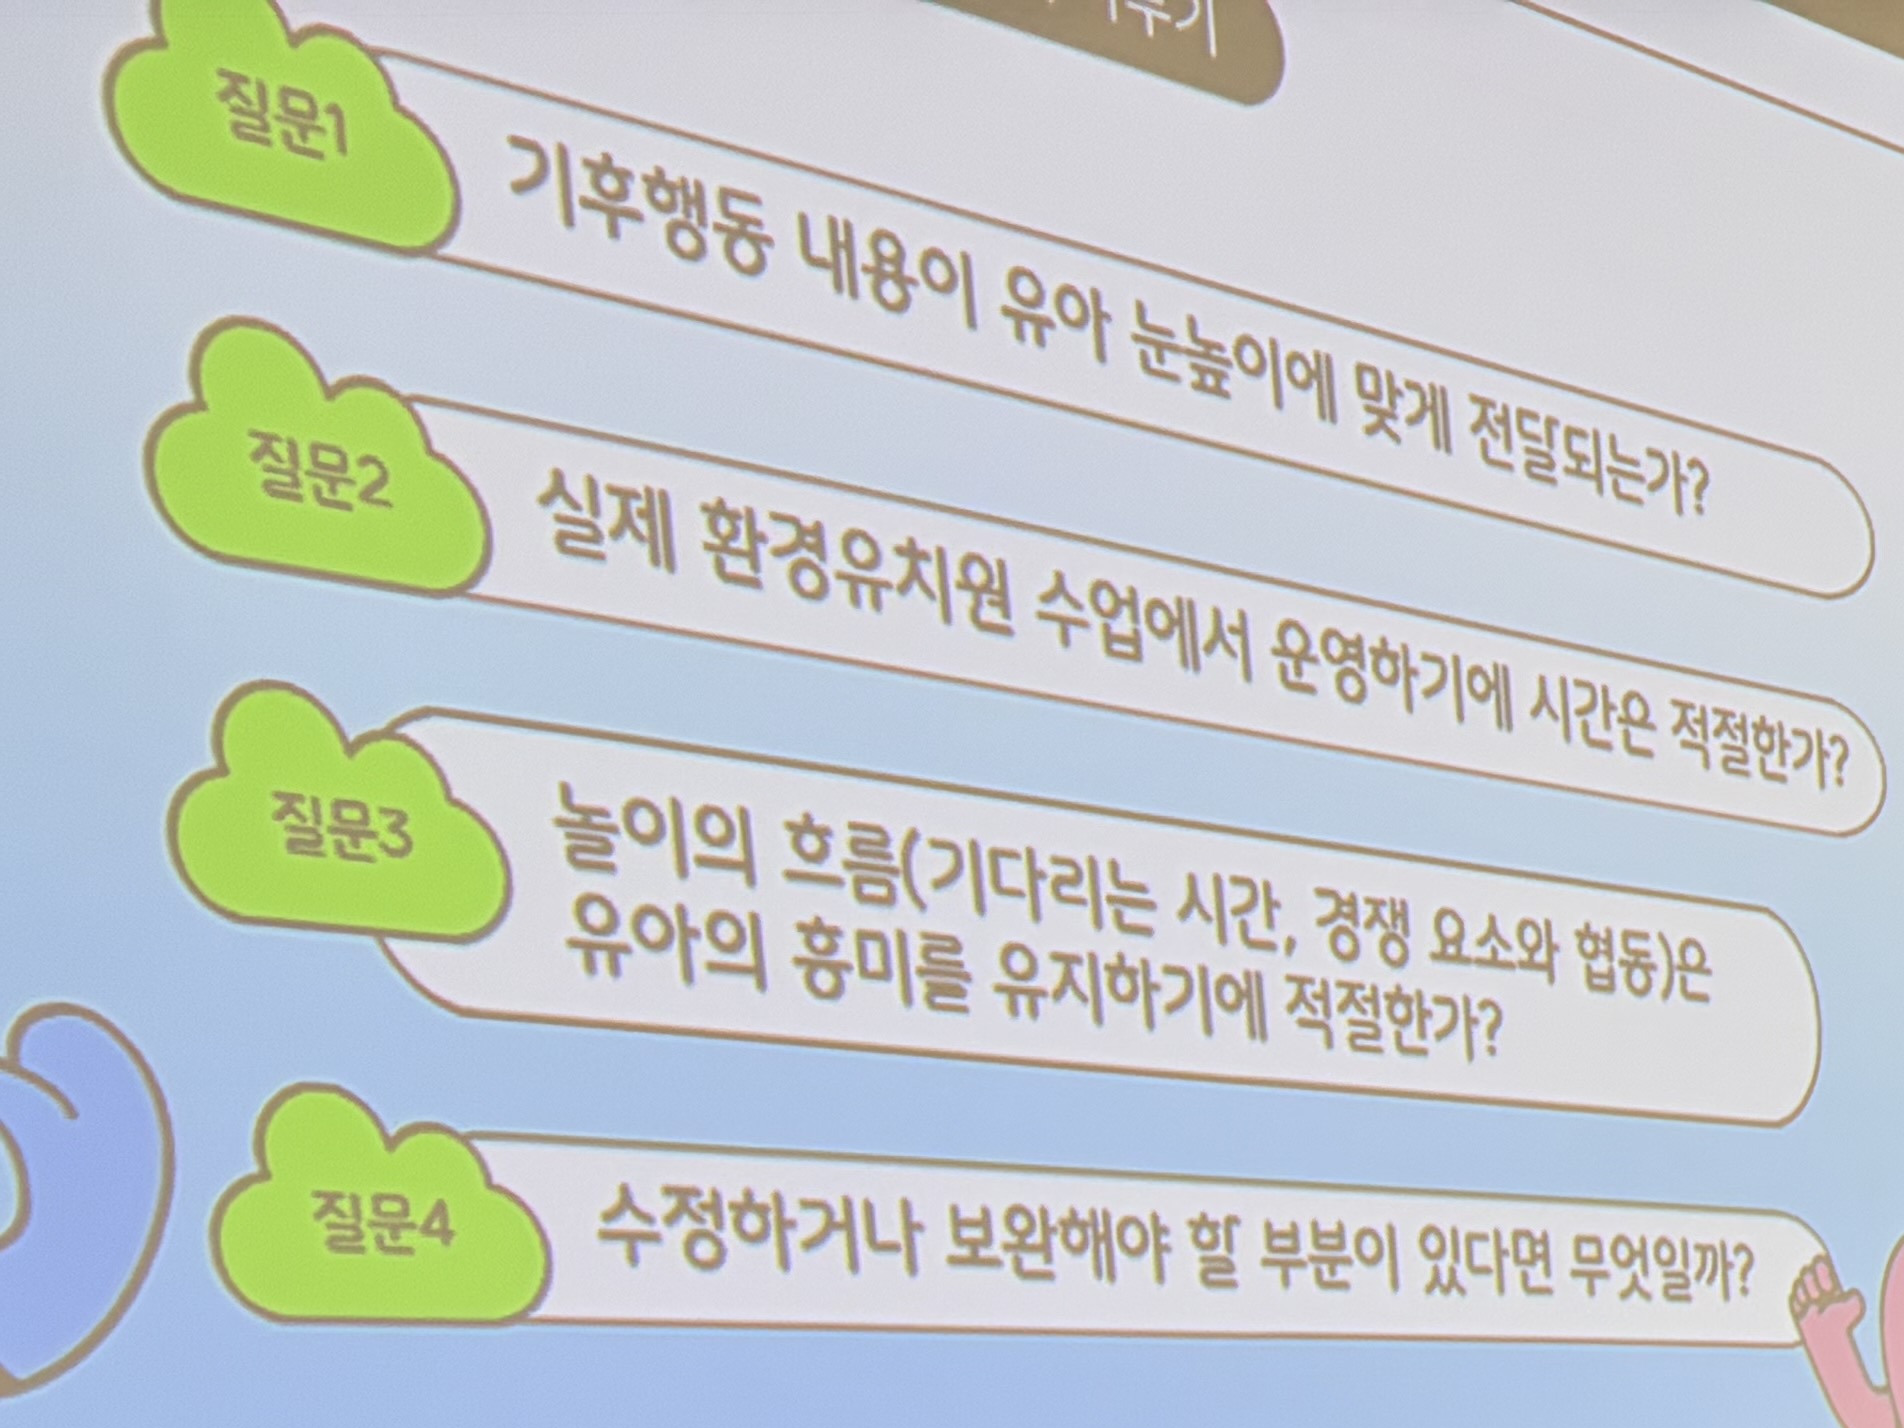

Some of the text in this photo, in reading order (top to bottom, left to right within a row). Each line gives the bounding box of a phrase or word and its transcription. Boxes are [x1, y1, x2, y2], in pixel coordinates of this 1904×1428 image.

[216, 66, 349, 162] 질문1
[505, 133, 1712, 519] 기후행동 내용이 유아 눈높이에 맞게 전달되는가?
[247, 428, 395, 513] 질문2
[535, 466, 1851, 792] 실제 환경유치원 수업에서 운영하기에 시간은 적절한가?
[270, 789, 415, 865] 질문3
[551, 779, 1714, 1005] 놀이의 흐름(기다리는 시간, 경쟁 요소와 협동)은
[564, 890, 1505, 1065] 유아의 흥미를 유지하기에 적절한가?
[310, 1189, 457, 1257] 질문4
[596, 1180, 1757, 1305] 수정하거나 보완해야 할 부분이 있다면 무엇일까?
